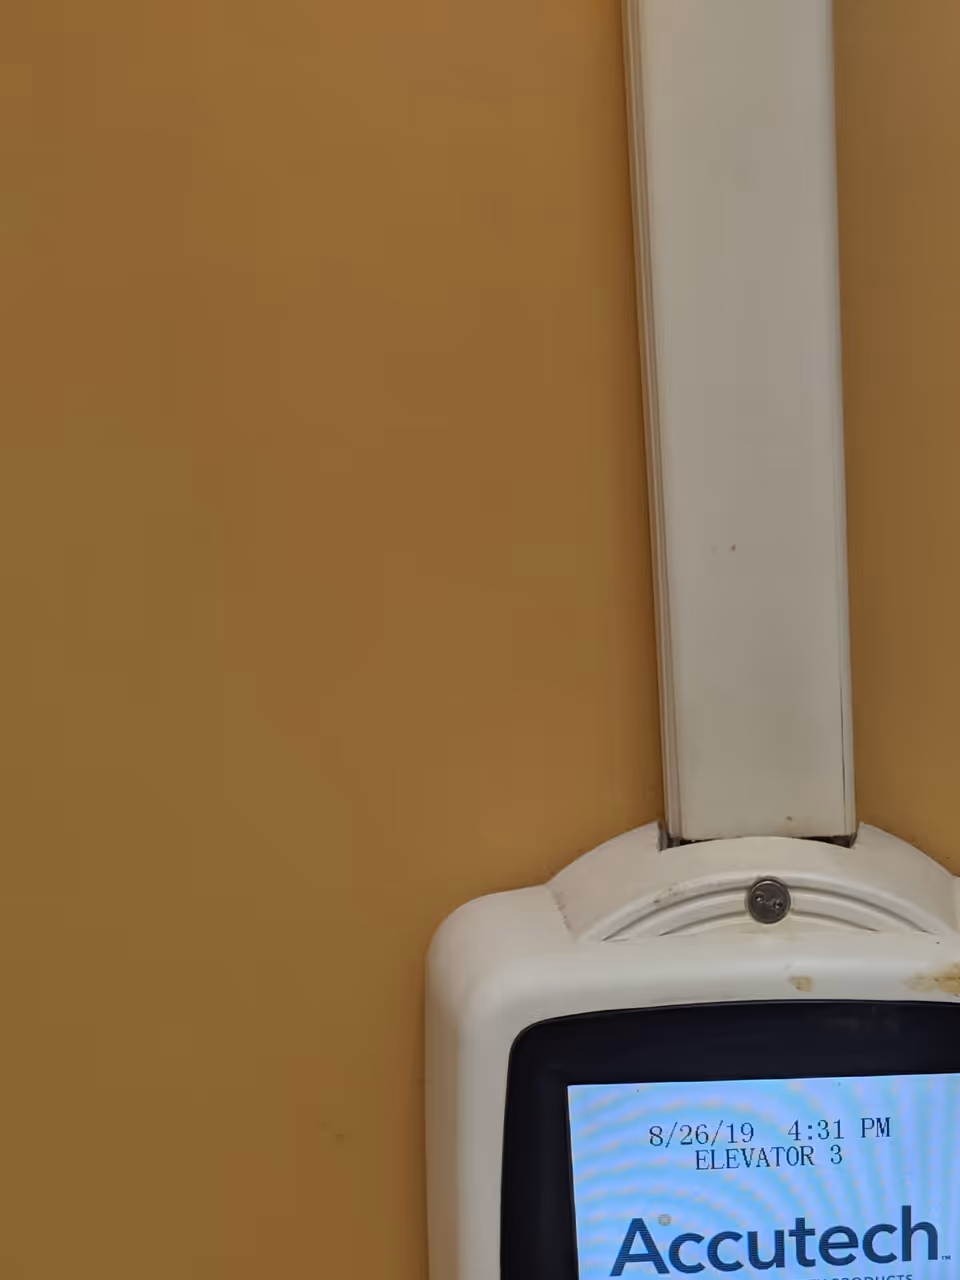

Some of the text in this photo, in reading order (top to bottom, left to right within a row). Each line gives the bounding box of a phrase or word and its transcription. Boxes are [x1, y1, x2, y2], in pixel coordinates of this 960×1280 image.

[648, 1116, 892, 1148] 8/26/19 4:31 PM
[694, 1144, 843, 1171] ELEVATOR 3
[609, 1204, 939, 1277] Accutech
